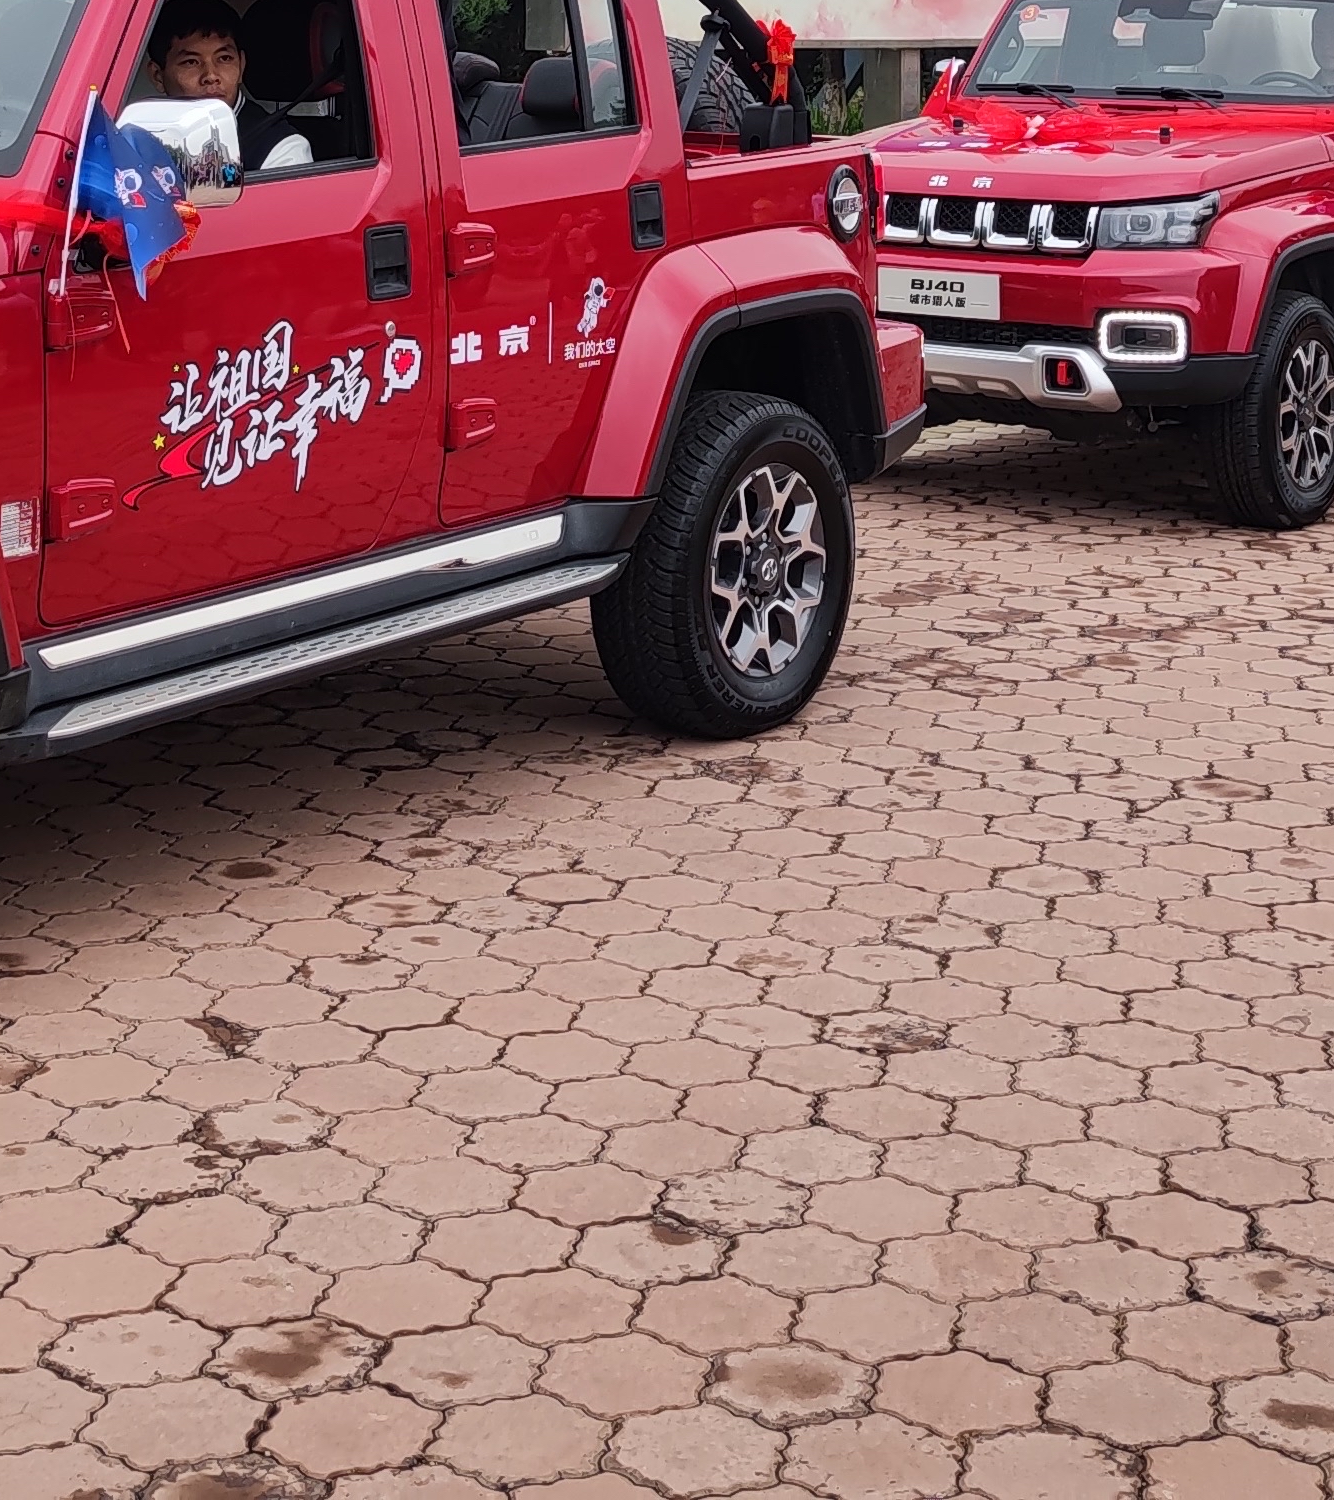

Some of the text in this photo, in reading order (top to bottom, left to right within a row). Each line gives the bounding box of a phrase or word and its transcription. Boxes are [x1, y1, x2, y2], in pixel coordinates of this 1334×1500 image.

[928, 175, 994, 189] 北京
[910, 278, 965, 294] BJ40
[909, 293, 967, 309] 城市猎人版
[450, 324, 530, 365] 北京
[563, 336, 617, 362] 我们的太空
[160, 318, 294, 435] 让祖国
[200, 347, 371, 493] 见证幸福
